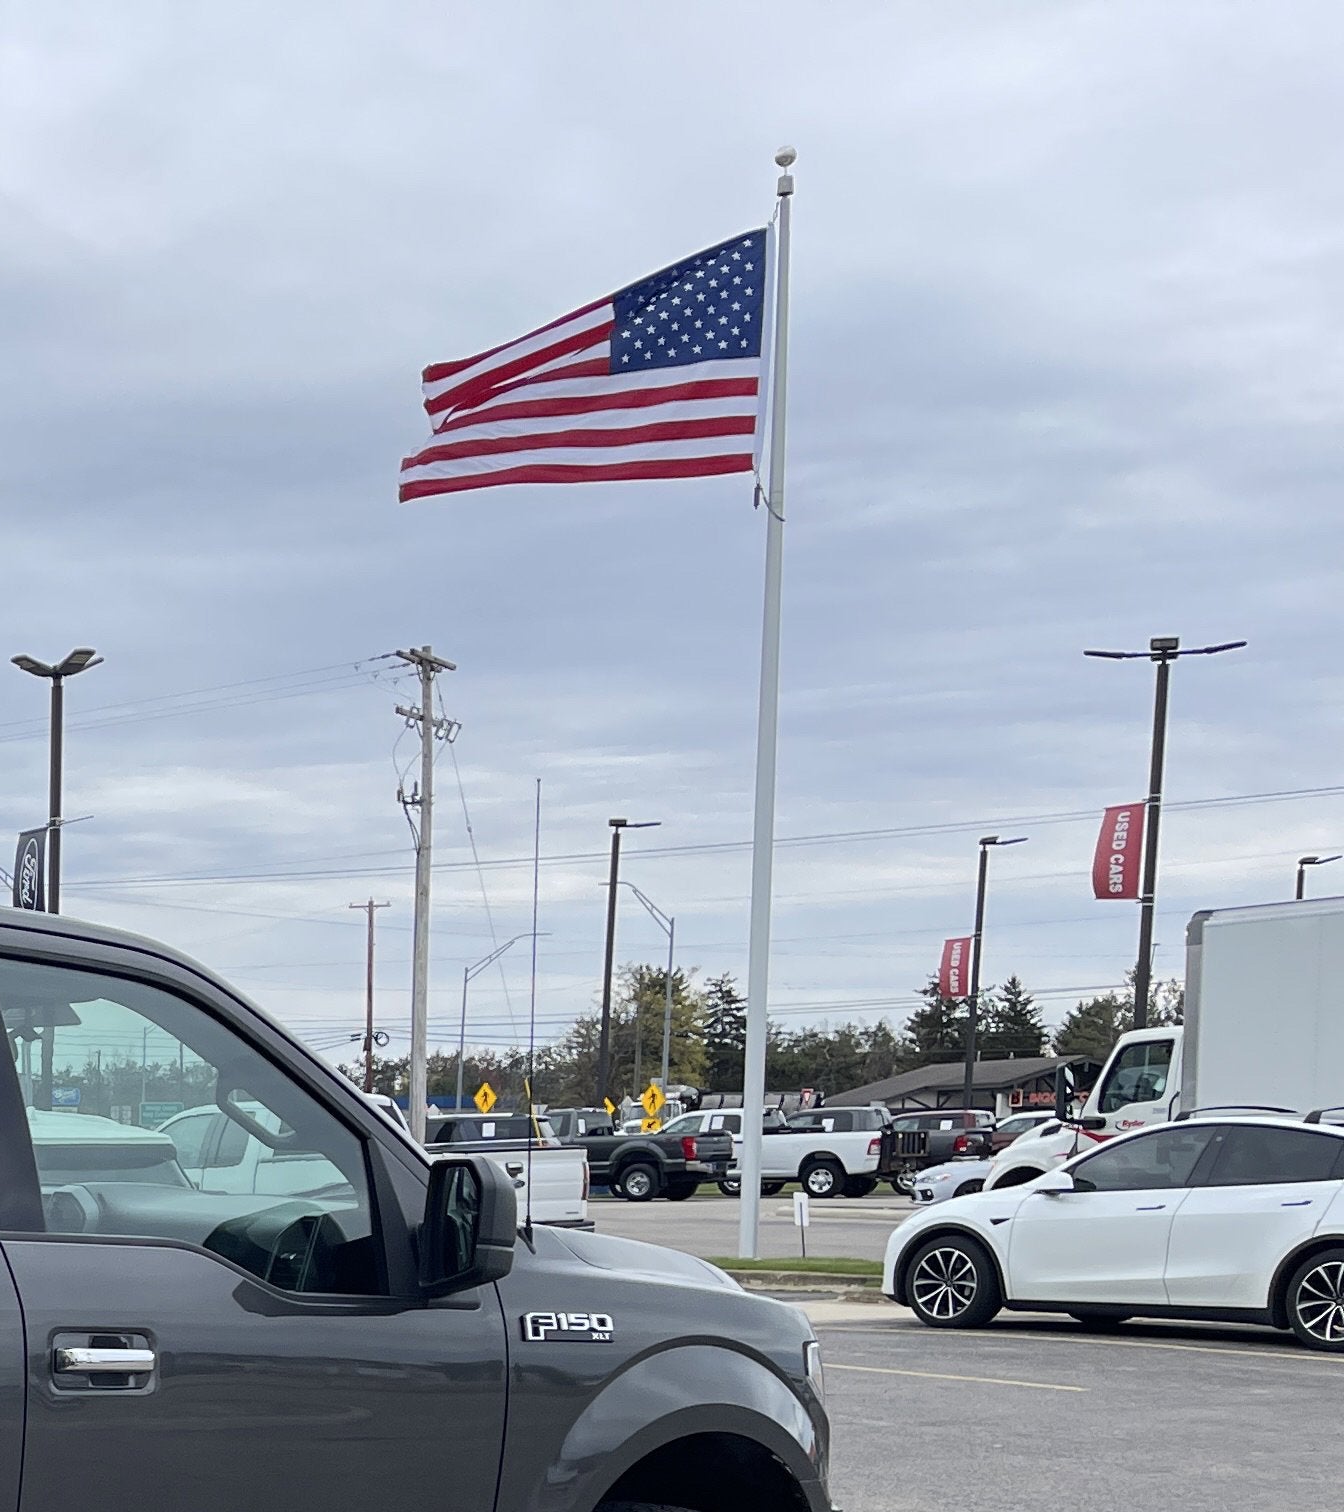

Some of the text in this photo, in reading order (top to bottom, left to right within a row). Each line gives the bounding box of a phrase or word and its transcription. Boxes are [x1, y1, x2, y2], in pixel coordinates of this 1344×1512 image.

[1109, 811, 1131, 893] USED CARS
[22, 853, 36, 904] Ford
[949, 942, 963, 993] USED CARS
[1122, 1119, 1146, 1128] Ryder
[591, 1332, 611, 1340] XLT
